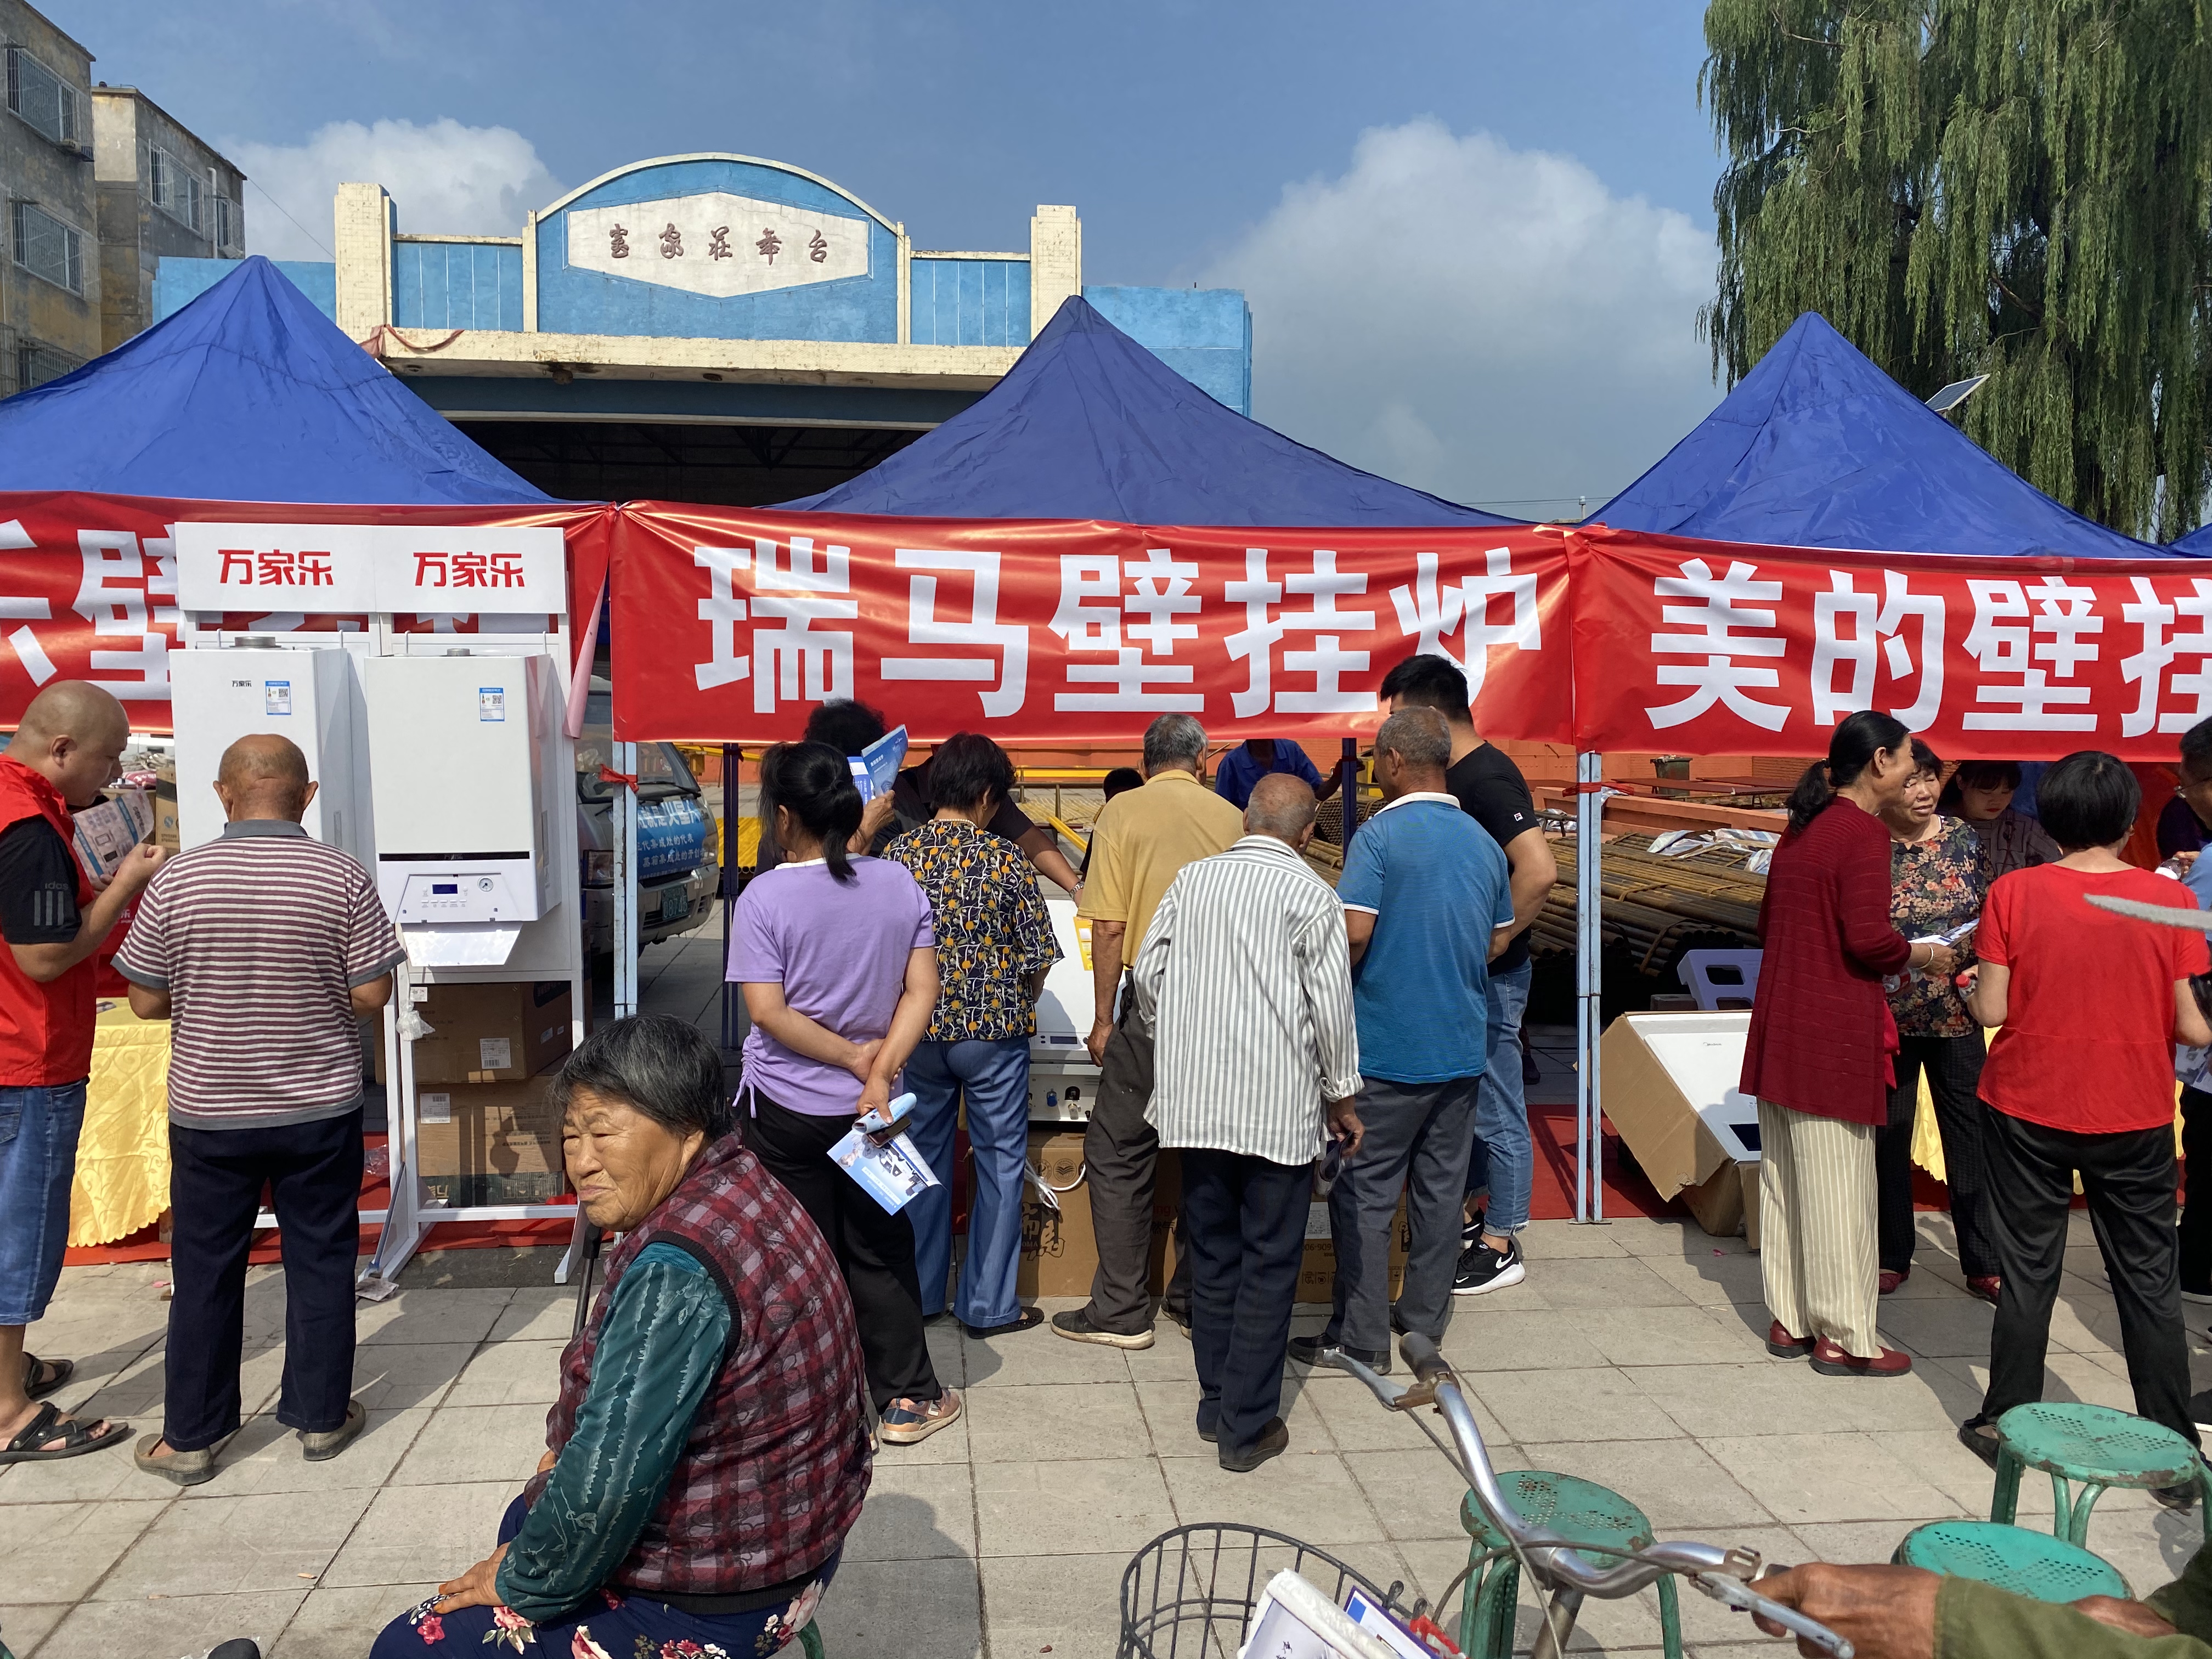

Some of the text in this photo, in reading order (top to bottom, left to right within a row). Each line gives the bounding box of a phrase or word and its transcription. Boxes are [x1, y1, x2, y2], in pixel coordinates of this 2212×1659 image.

[217, 549, 334, 586] 万家乐
[413, 551, 526, 588] 万家乐
[693, 536, 1543, 719] 瑞马壁挂炉
[1644, 557, 2212, 738] 美的壁挂
